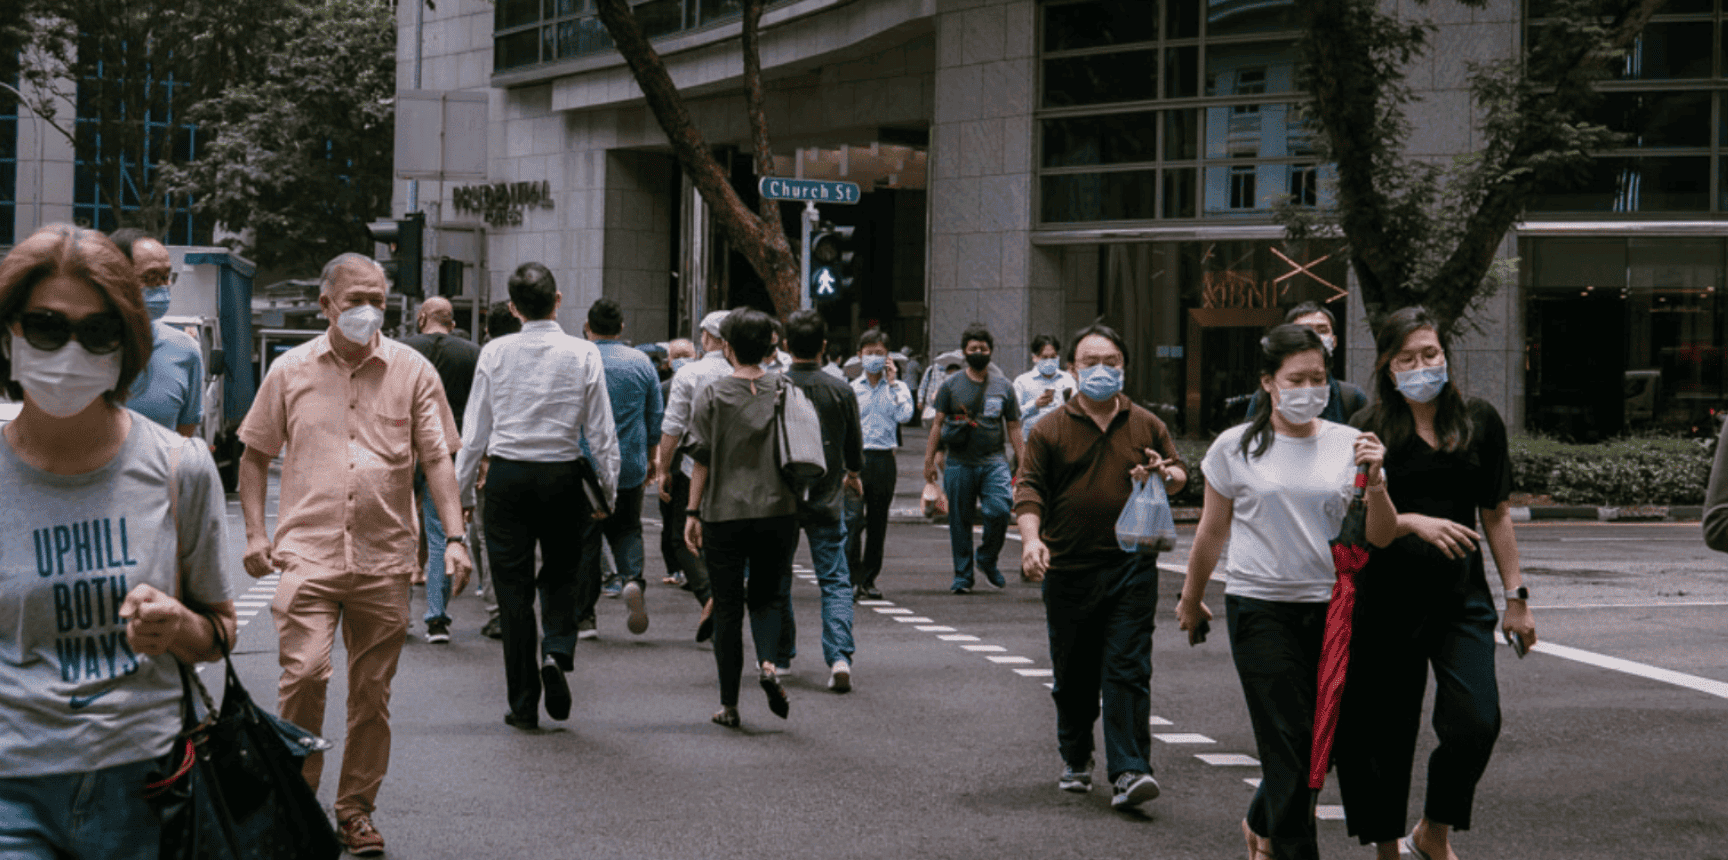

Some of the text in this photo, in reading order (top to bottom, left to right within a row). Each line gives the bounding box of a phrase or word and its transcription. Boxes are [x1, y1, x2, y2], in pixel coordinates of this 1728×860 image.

[769, 180, 852, 201] Church St
[33, 517, 138, 578] UPHILL
[53, 573, 129, 633] BOTH
[55, 631, 139, 683] WAYS
